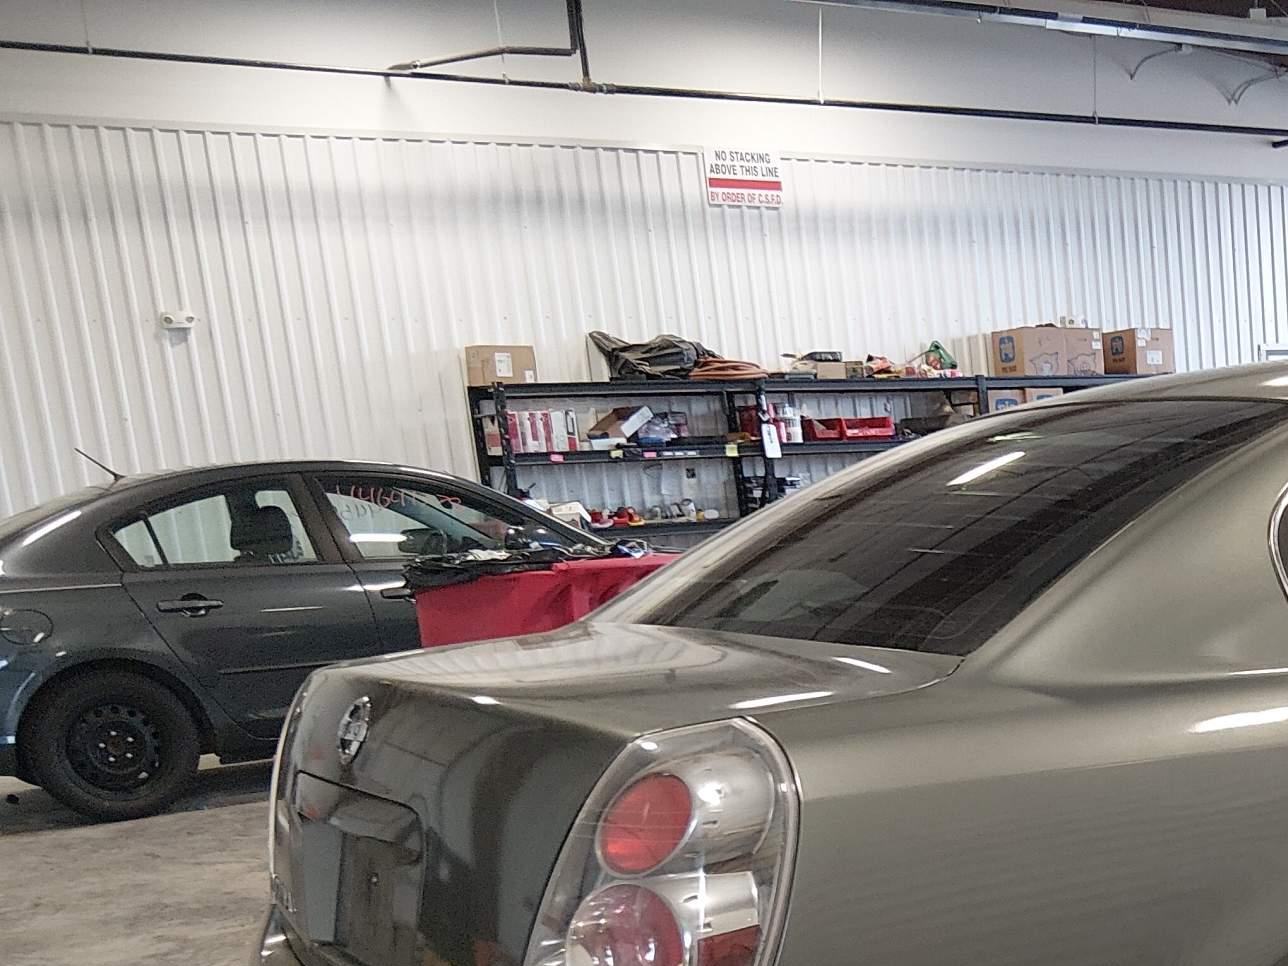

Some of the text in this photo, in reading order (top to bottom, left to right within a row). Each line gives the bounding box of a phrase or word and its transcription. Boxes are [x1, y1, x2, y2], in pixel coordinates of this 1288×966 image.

[714, 150, 771, 164] NO STACKING
[709, 163, 780, 178] ABOVE THIS LINE
[710, 191, 720, 202] BY
[721, 192, 746, 203] ORDER
[747, 193, 757, 203] OF
